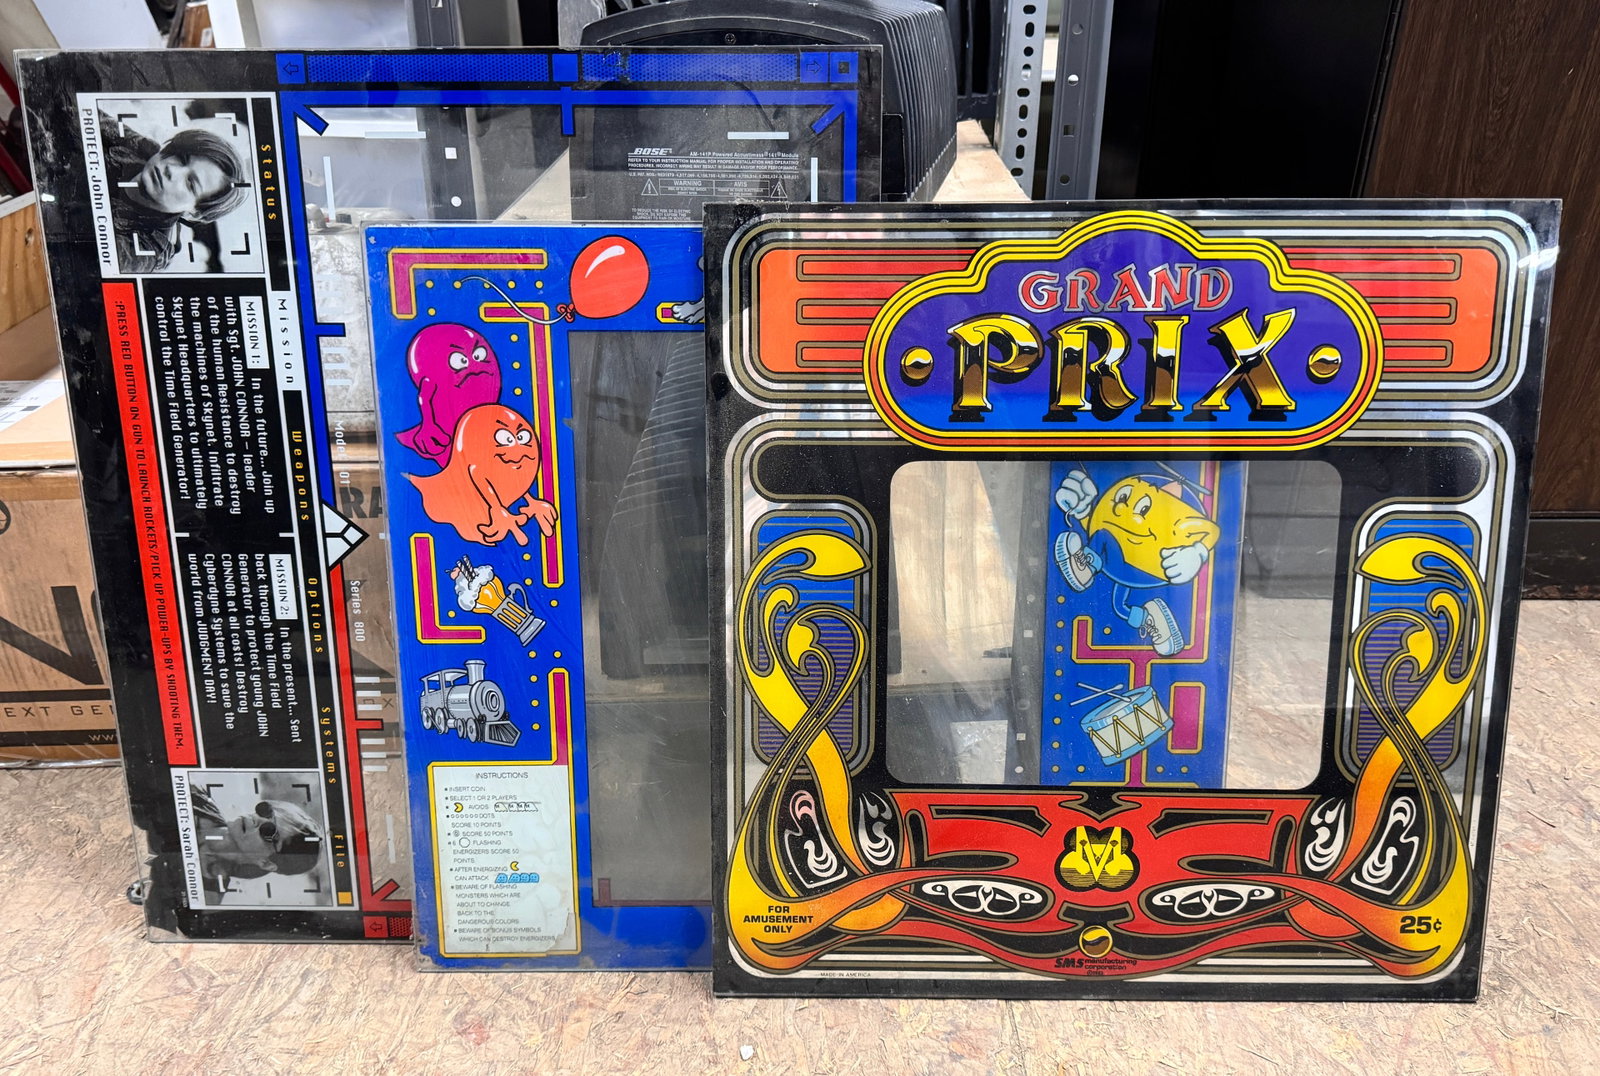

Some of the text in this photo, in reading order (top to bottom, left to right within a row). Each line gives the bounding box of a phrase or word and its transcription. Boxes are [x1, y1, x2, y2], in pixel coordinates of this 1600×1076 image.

[260, 144, 279, 220] Status
[632, 148, 668, 156] BOSE
[80, 108, 113, 264] PROTECT: John Connor
[1018, 262, 1234, 313] GRAND
[120, 340, 132, 360] RED
[277, 298, 294, 383] Mission
[946, 307, 1298, 421] PRIX
[123, 364, 137, 402] BUTTON
[129, 406, 140, 420] ON
[154, 296, 190, 499] control the Time Field Generator!
[169, 296, 208, 508] Skynet Headquarters to ultimately
[189, 296, 224, 506] the machines of Skynet. Infiltrate
[206, 296, 242, 514] of the human Resistance to destroy
[224, 296, 256, 492] with Sgt. JOHN CONNOR leader
[244, 301, 274, 513] MISSION 1: In the future... Join up
[131, 424, 143, 444] GUN
[134, 449, 145, 459] TO
[136, 463, 151, 502] LAUNCH
[290, 431, 310, 521] Weapons
[339, 471, 350, 484] 01
[142, 506, 161, 579] ROCKETS/PICK
[153, 583, 164, 595] UP
[305, 578, 324, 653] Options
[349, 580, 365, 641] Series 800
[155, 598, 172, 654] POWER-UPS
[187, 553, 216, 703] world from JUDGMENT DAY!
[201, 553, 235, 729] Cyberdyne Systems to save the
[220, 553, 249, 713] CONNOR at all costs! Destroy
[237, 553, 268, 736] Generator to protect young JOHN
[254, 553, 281, 708] back through the Time Field
[274, 558, 301, 742] MISSION 2: In the present... Sent
[163, 658, 174, 669] BY
[165, 674, 180, 718] SHOOTING
[172, 722, 185, 749] THEM.
[319, 707, 337, 784] Systems
[174, 775, 200, 901] PROTECT: Sarah Connor
[333, 835, 346, 868] File
[743, 915, 814, 924] AMUSEMENT
[764, 925, 793, 933] ONLY
[768, 905, 790, 914] FOR
[1400, 916, 1442, 934] 25¢
[1054, 958, 1137, 968] SMS manufacturing
